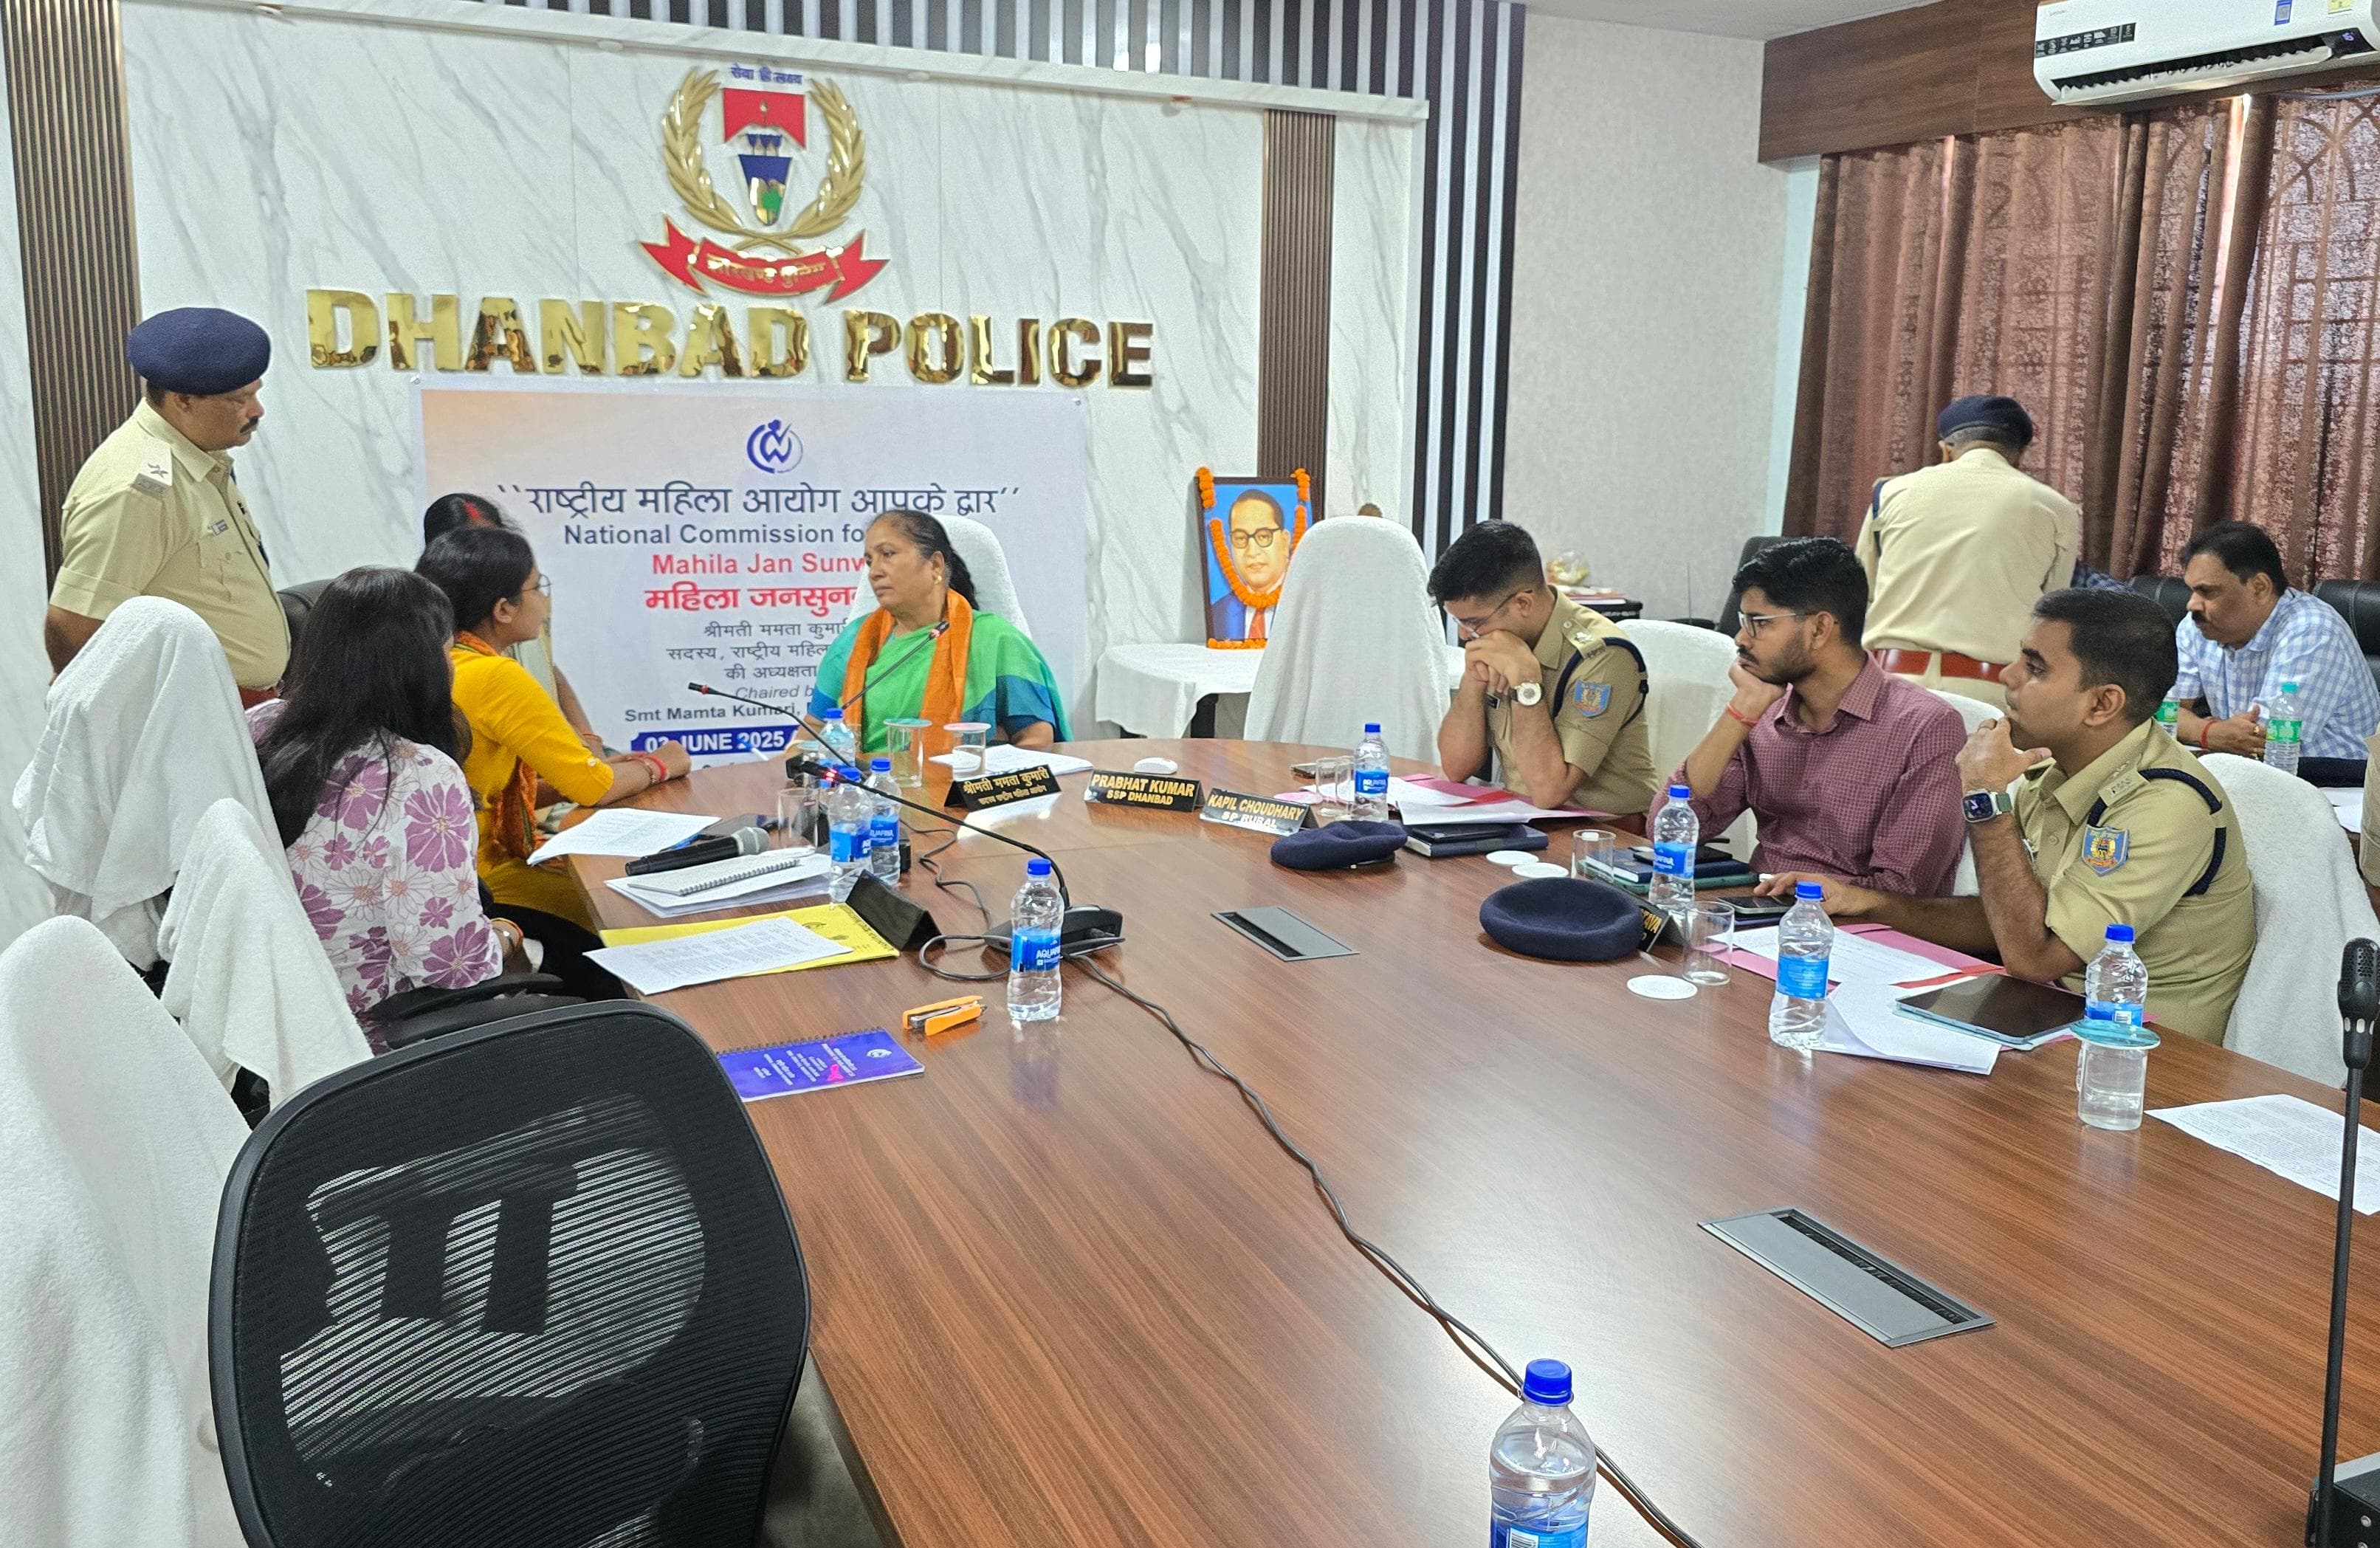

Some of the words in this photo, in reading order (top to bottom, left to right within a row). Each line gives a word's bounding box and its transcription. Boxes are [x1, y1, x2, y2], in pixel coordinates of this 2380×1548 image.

[306, 288, 809, 379] DHANBAD
[845, 309, 1154, 388] POLICE
[636, 480, 732, 515] महिला
[743, 482, 841, 513] आयोग
[851, 483, 948, 514] आपके
[564, 524, 670, 545] National
[680, 523, 833, 544] Commission
[842, 523, 864, 543] fo
[653, 554, 737, 574] Mahila
[747, 553, 792, 574] Jan
[802, 552, 866, 574] Sunw
[644, 581, 741, 611] महिला
[747, 586, 858, 618] जनसुन
[704, 619, 752, 638] श्रीमती
[759, 623, 801, 637] ममता
[666, 647, 724, 660] सदस्य,
[730, 641, 781, 660] राष्ट्रीय
[787, 640, 830, 658] महिल
[724, 663, 746, 680] की
[753, 665, 817, 678] अध्यक्षता
[736, 686, 799, 698] Chaired
[805, 685, 814, 697] b
[625, 709, 661, 722] Smt
[667, 706, 726, 720] Mamta
[738, 730, 785, 749] 2025
[963, 777, 993, 794] श्रीमती
[992, 774, 1020, 788] ममता
[1019, 766, 1049, 786] कुमारी
[1091, 774, 1148, 792] PRABHAT
[1149, 780, 1195, 797] KUMAR
[1107, 790, 1127, 800] SSP
[1127, 792, 1174, 805] DHANBAD
[1208, 794, 1237, 811] KAPIL
[1239, 799, 1304, 821] CHOUDHARY
[1222, 811, 1238, 822] SP
[1240, 813, 1277, 828] RURAL
